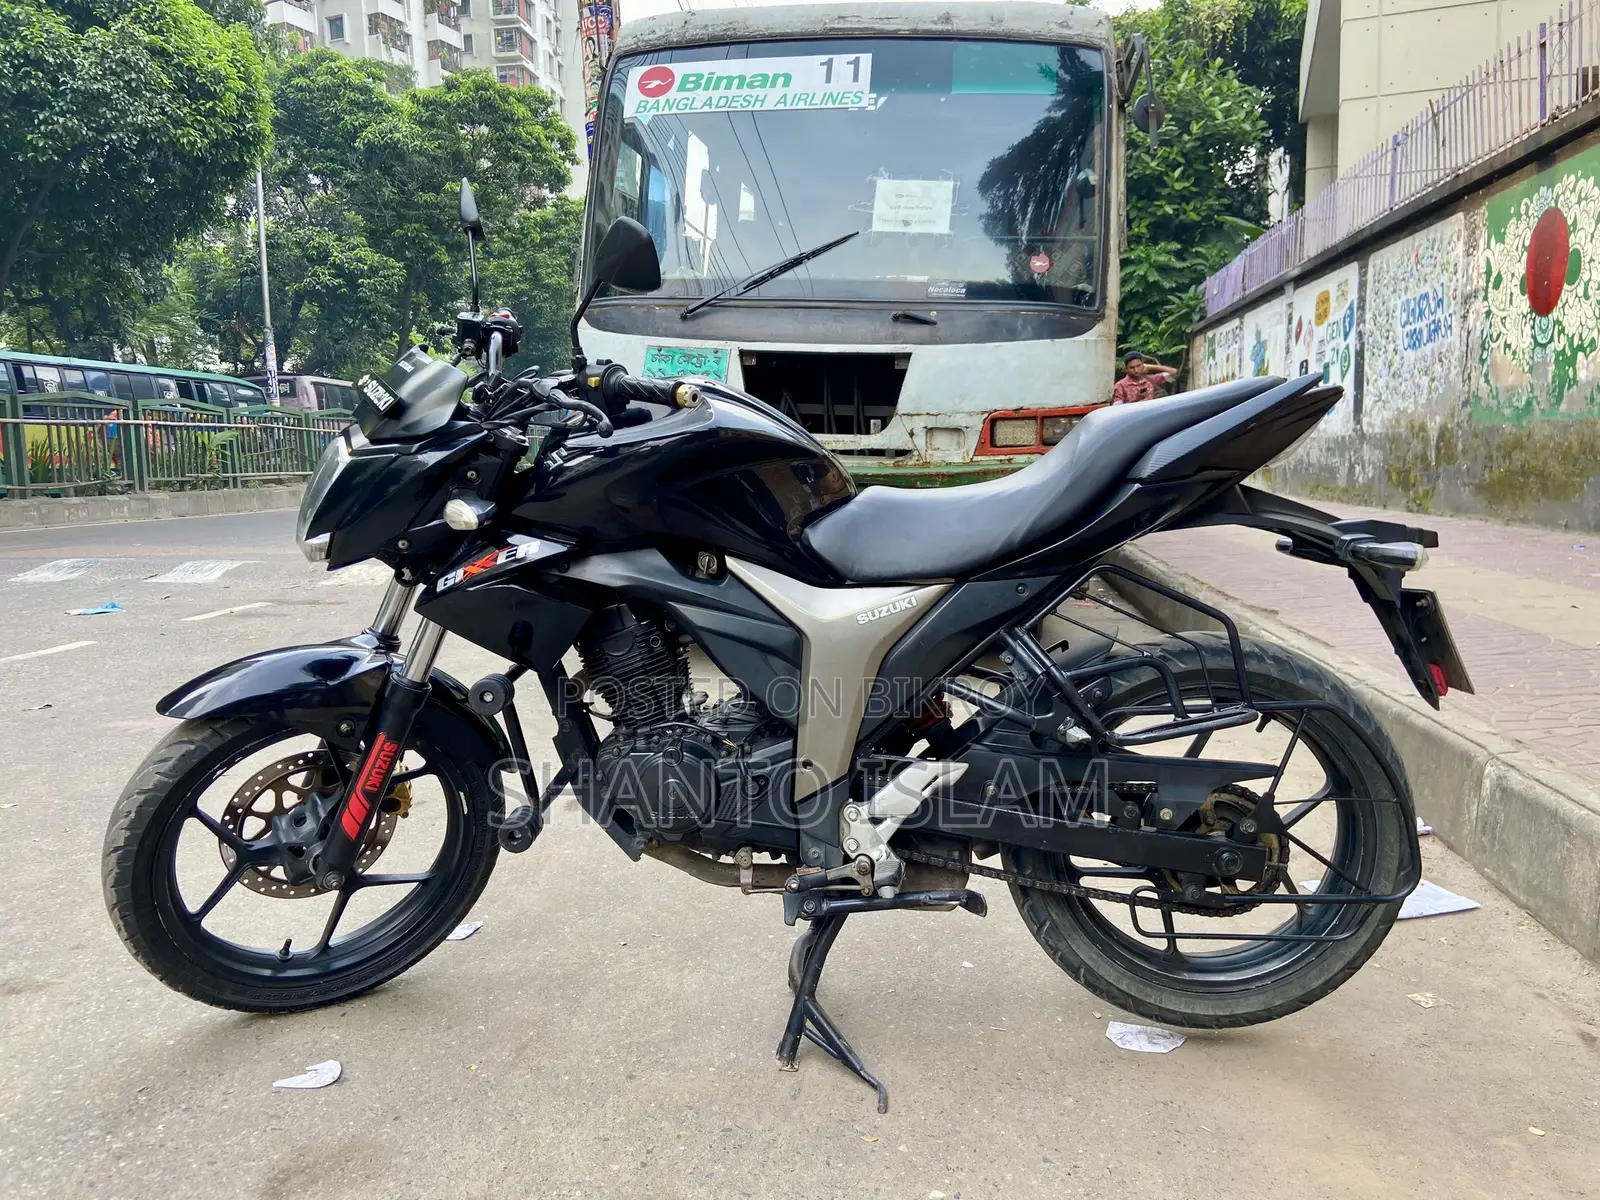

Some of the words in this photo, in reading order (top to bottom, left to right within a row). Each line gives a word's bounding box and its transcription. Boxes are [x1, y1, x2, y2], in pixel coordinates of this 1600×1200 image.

[676, 72, 792, 93] Biman
[635, 94, 765, 114] BANGLADESH
[774, 90, 864, 109] AIRLINES
[651, 353, 676, 364] ঢাকা
[363, 379, 395, 411] SUZUKI
[856, 596, 917, 625] SUZUKI
[364, 741, 399, 792] SUZUKI
